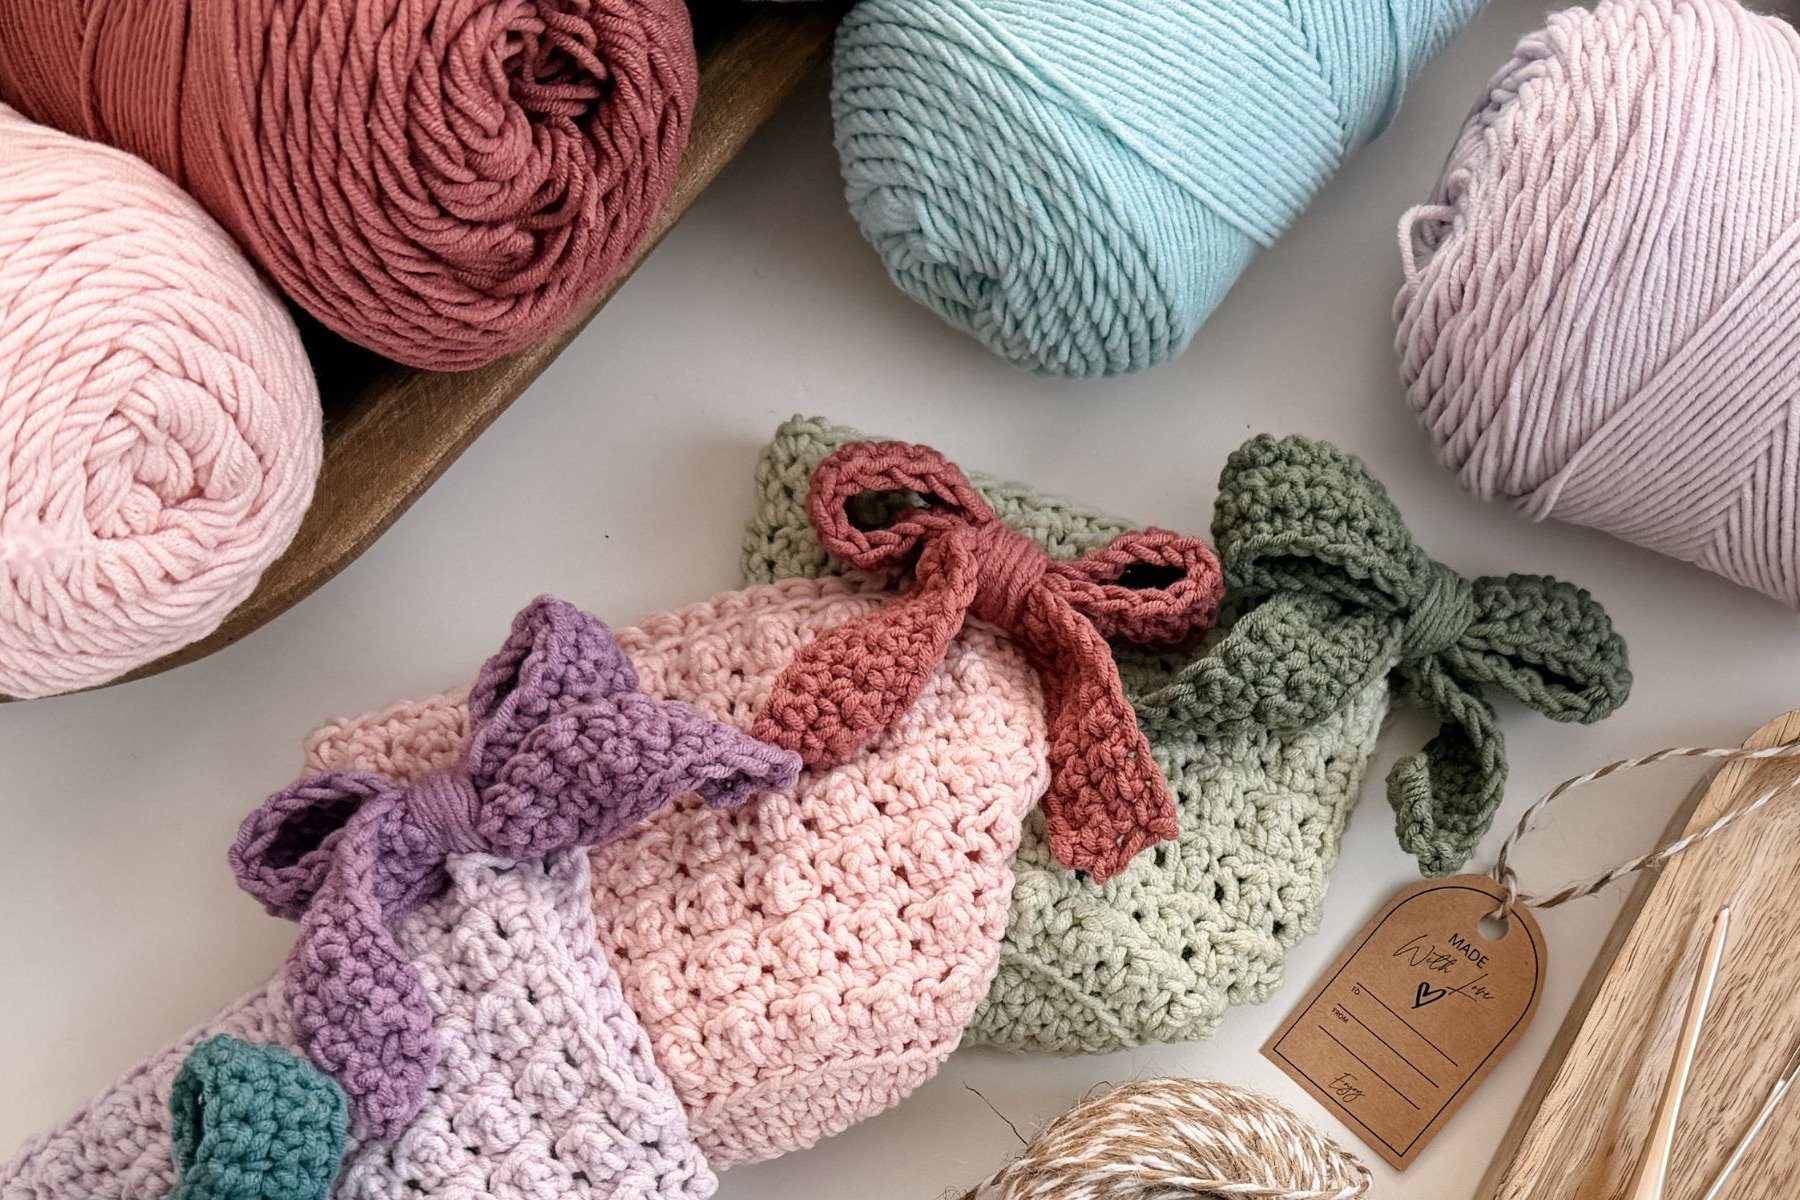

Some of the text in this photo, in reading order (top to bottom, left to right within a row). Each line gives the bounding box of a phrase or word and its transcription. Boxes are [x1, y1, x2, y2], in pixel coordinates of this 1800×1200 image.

[1392, 934, 1457, 974] With
[1448, 932, 1490, 969] MADE
[1350, 985, 1361, 996] TO
[1331, 1007, 1350, 1025] FROM
